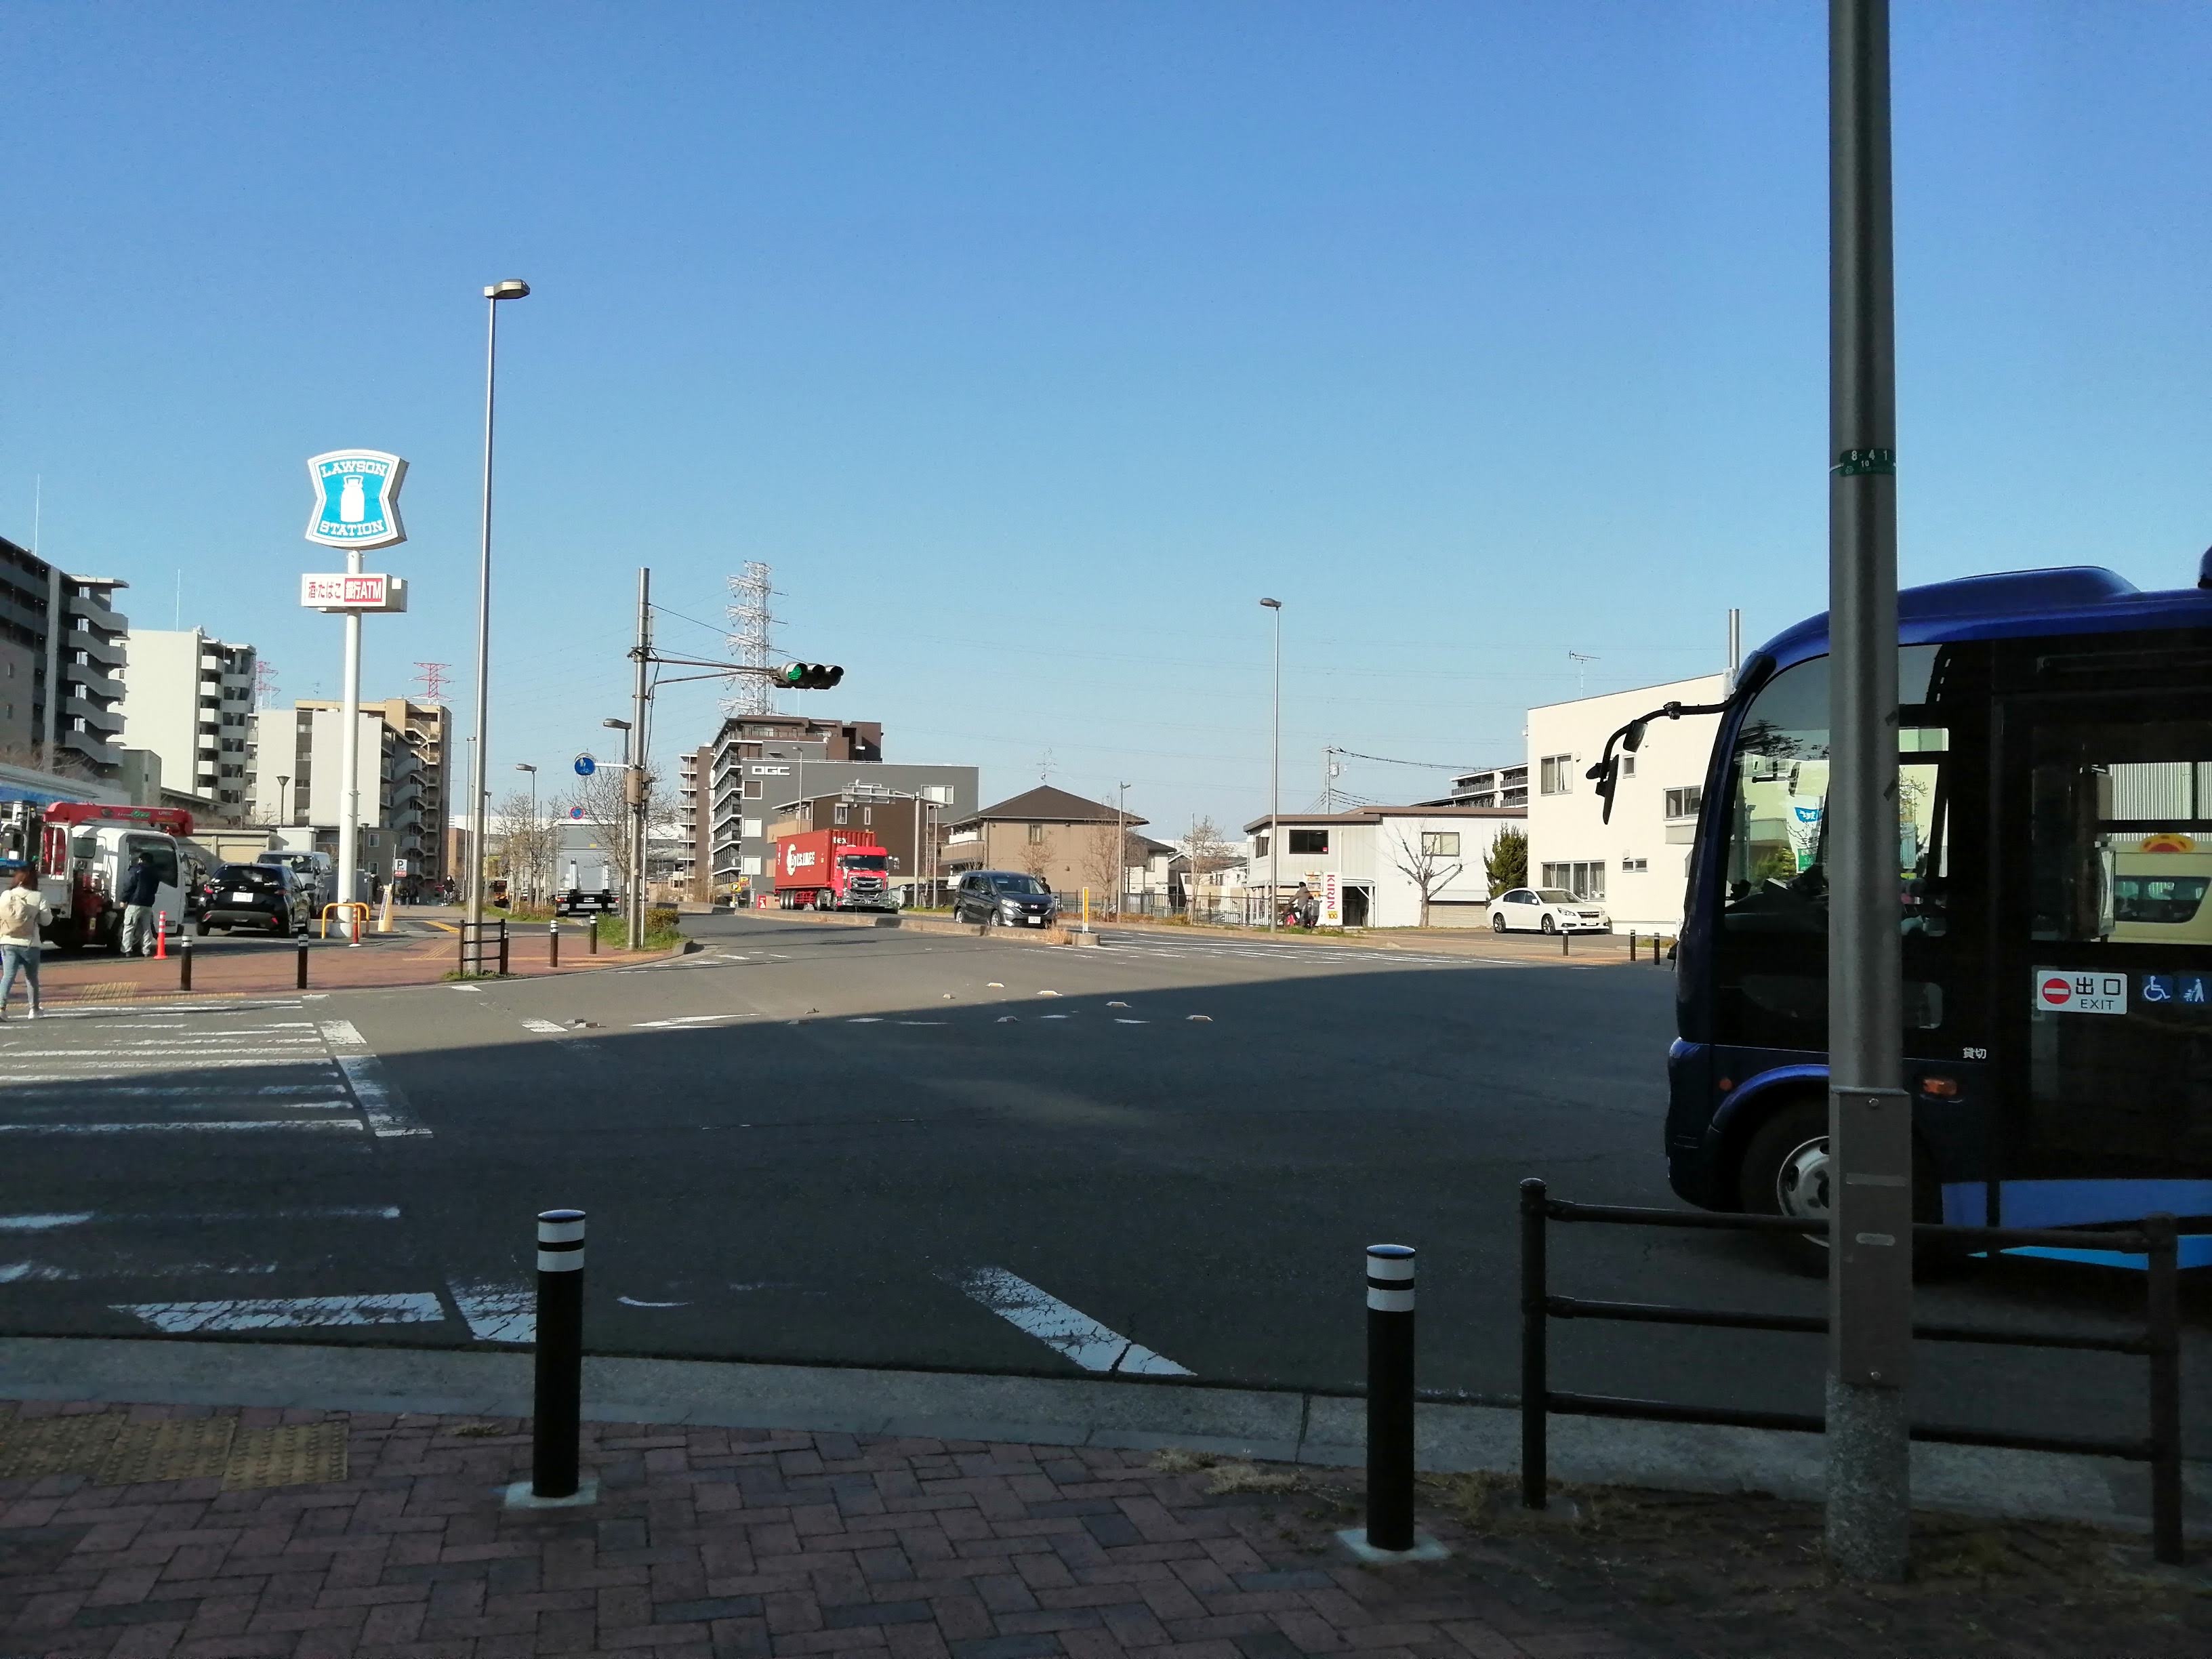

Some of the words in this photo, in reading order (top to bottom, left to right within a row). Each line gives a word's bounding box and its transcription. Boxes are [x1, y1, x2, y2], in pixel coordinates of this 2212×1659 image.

[321, 460, 387, 478] LAWSON
[320, 520, 385, 536] STATION
[397, 860, 403, 869] P
[1327, 875, 1335, 909] KIRIN
[2076, 977, 2121, 996] 出口
[2081, 999, 2114, 1010] EXIT
[1963, 1047, 1986, 1059] 貸切
